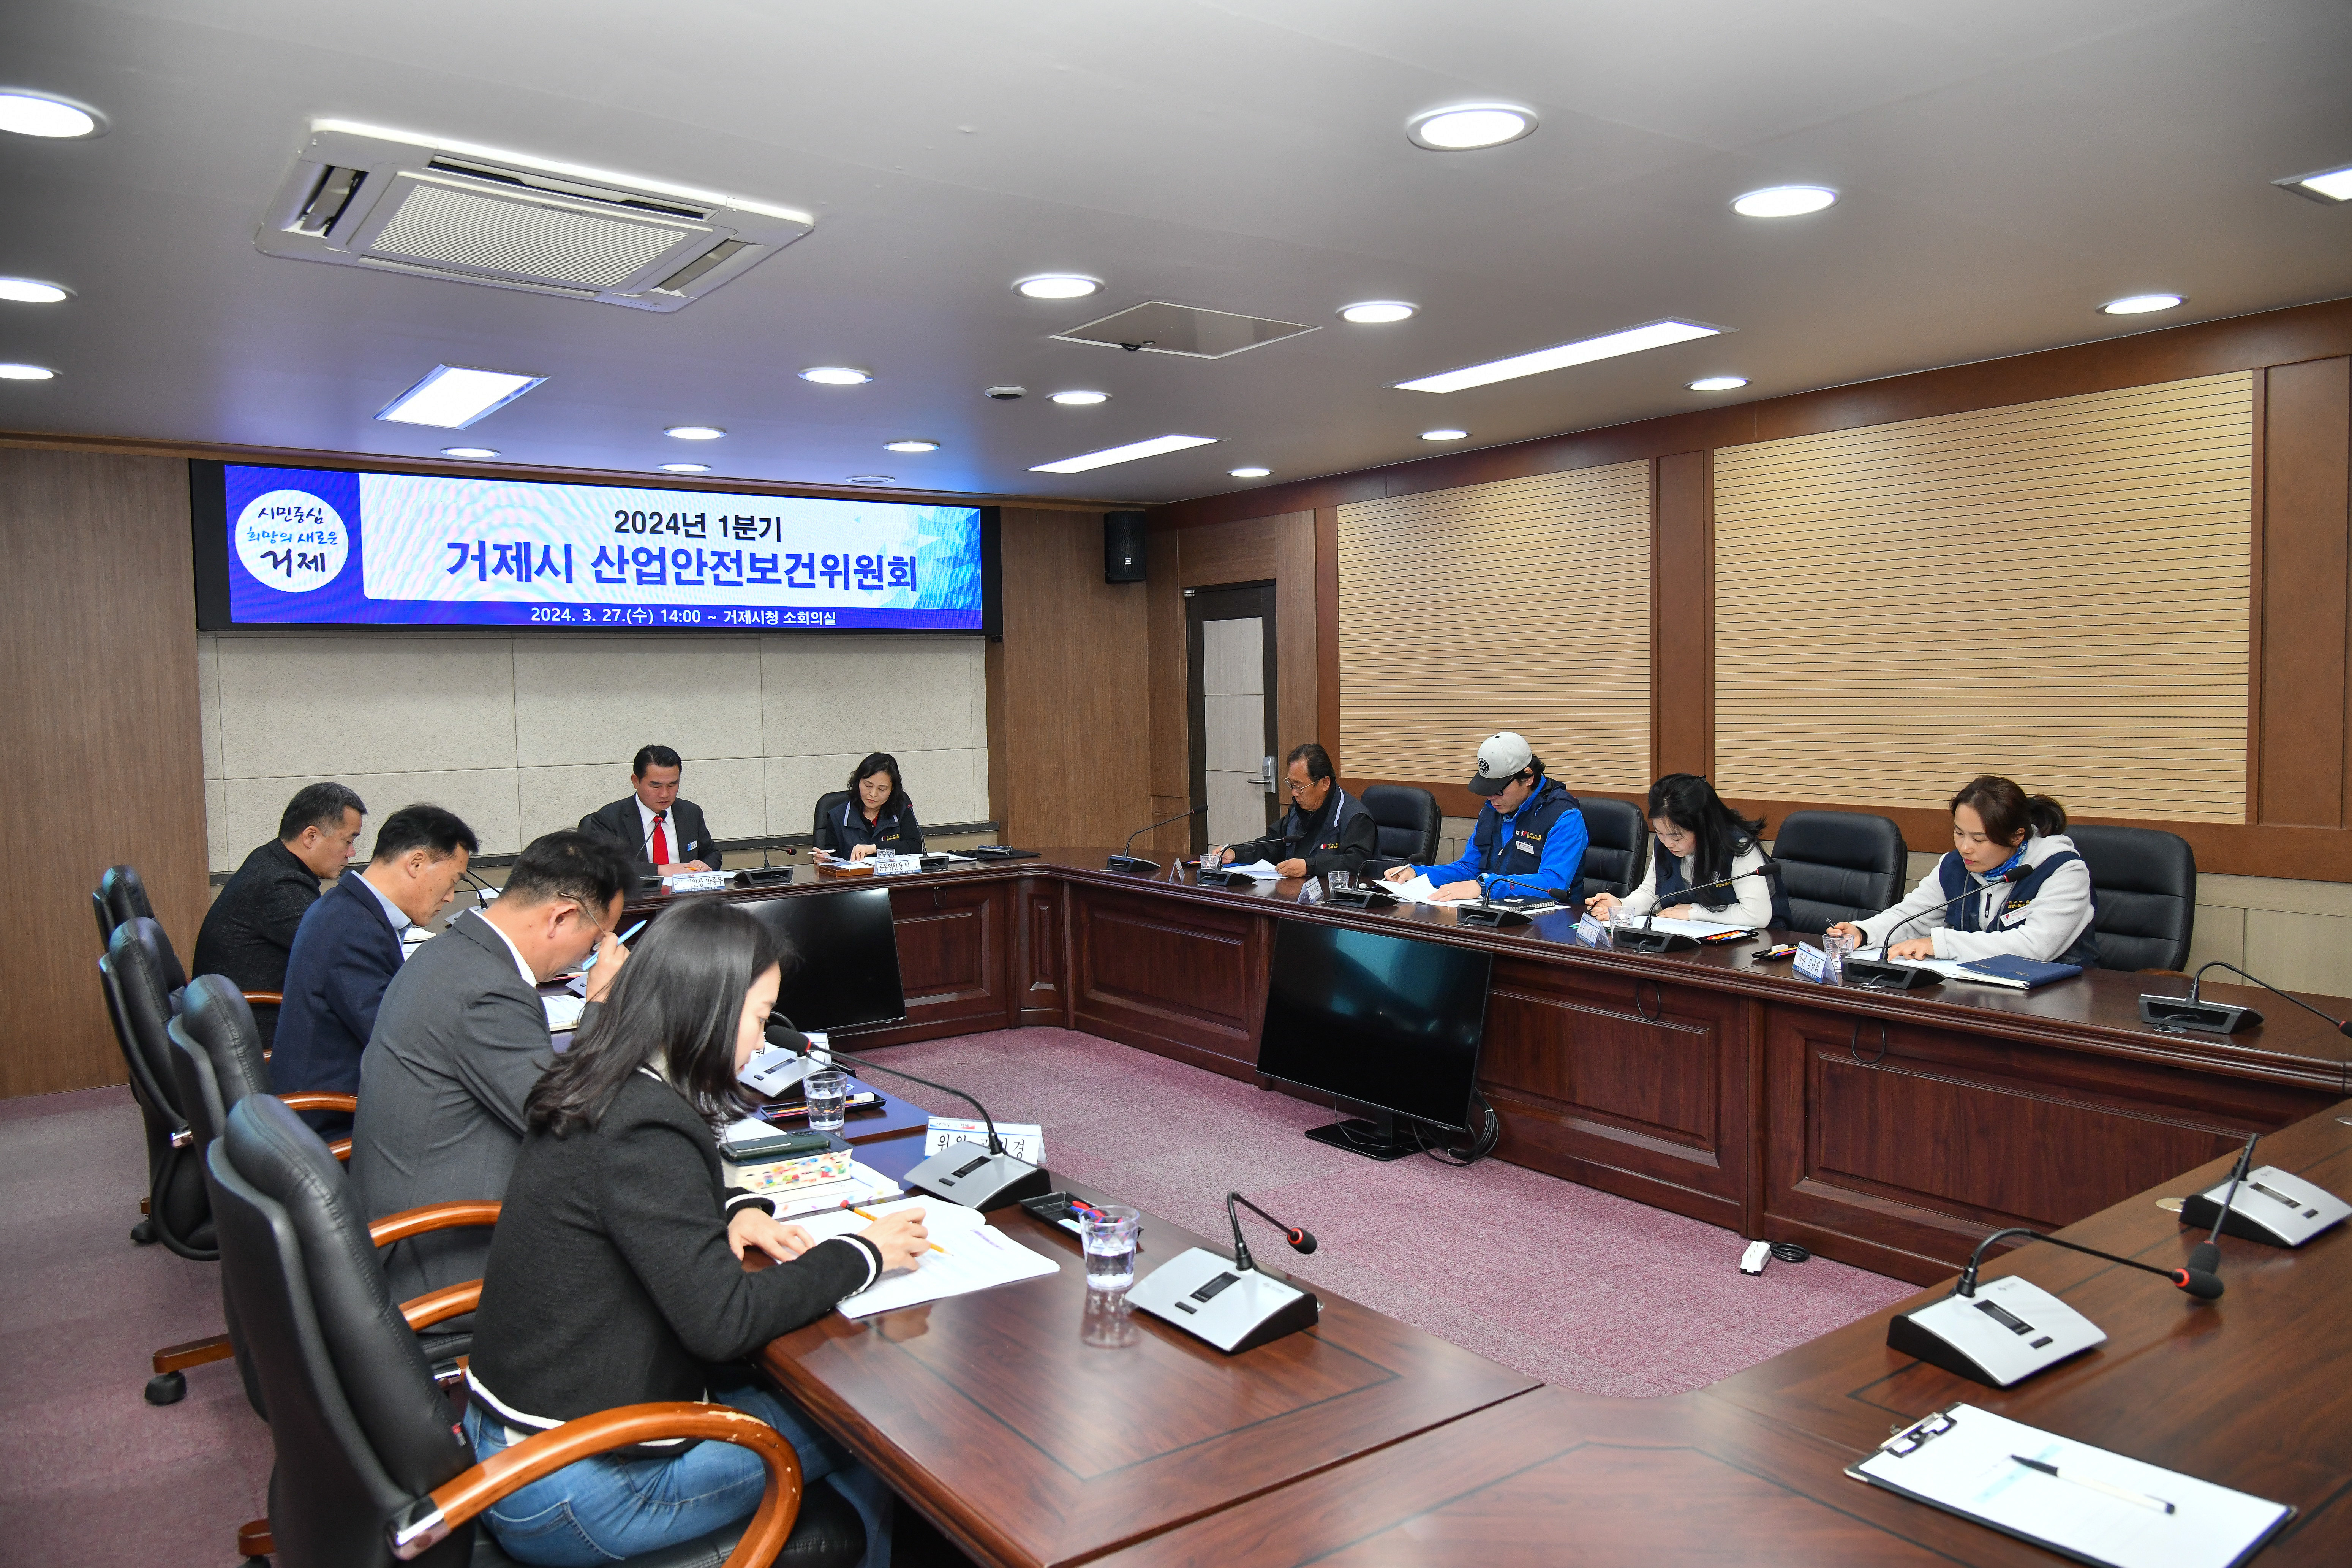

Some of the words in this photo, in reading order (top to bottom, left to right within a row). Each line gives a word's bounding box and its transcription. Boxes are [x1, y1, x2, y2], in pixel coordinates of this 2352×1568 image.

[258, 506, 324, 524] 시민중심
[247, 526, 292, 544] 희망의
[297, 531, 338, 545] 새로운
[614, 510, 707, 539] 2024년
[718, 514, 781, 542] 1분기
[260, 548, 326, 578] 거제
[446, 540, 573, 584] 거제시
[590, 545, 917, 592] 산업안전보건위원회
[531, 607, 575, 622] 2024.
[582, 608, 596, 622] 3.
[602, 607, 654, 625] 27.(수)
[661, 609, 701, 623] 14:00
[724, 610, 778, 626] 거제시청
[783, 610, 836, 626] 소회의실
[878, 862, 903, 872] 공동위원장
[706, 877, 723, 886] 박종우
[1798, 952, 1807, 967] 위원
[1808, 957, 1821, 974] 김난희
